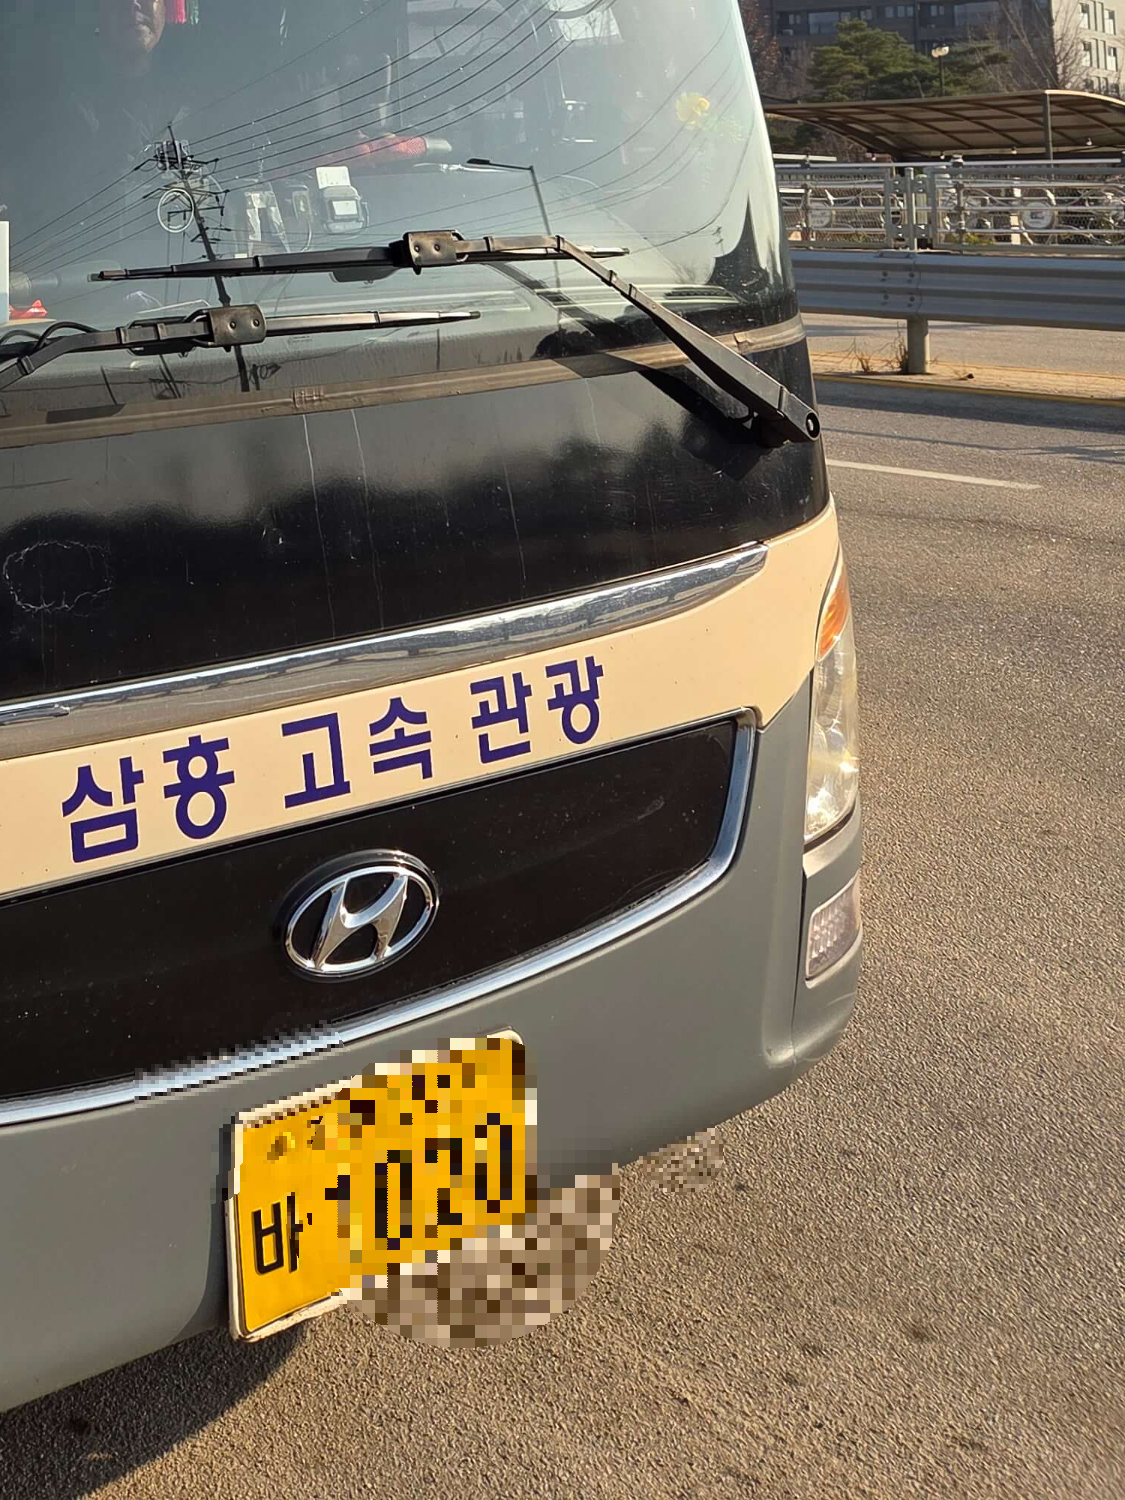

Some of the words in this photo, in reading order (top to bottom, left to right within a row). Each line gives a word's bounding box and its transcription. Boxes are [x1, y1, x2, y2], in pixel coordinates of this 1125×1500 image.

[62, 734, 235, 863] 삼흥
[281, 697, 433, 809] 고속
[470, 655, 604, 764] 관광
